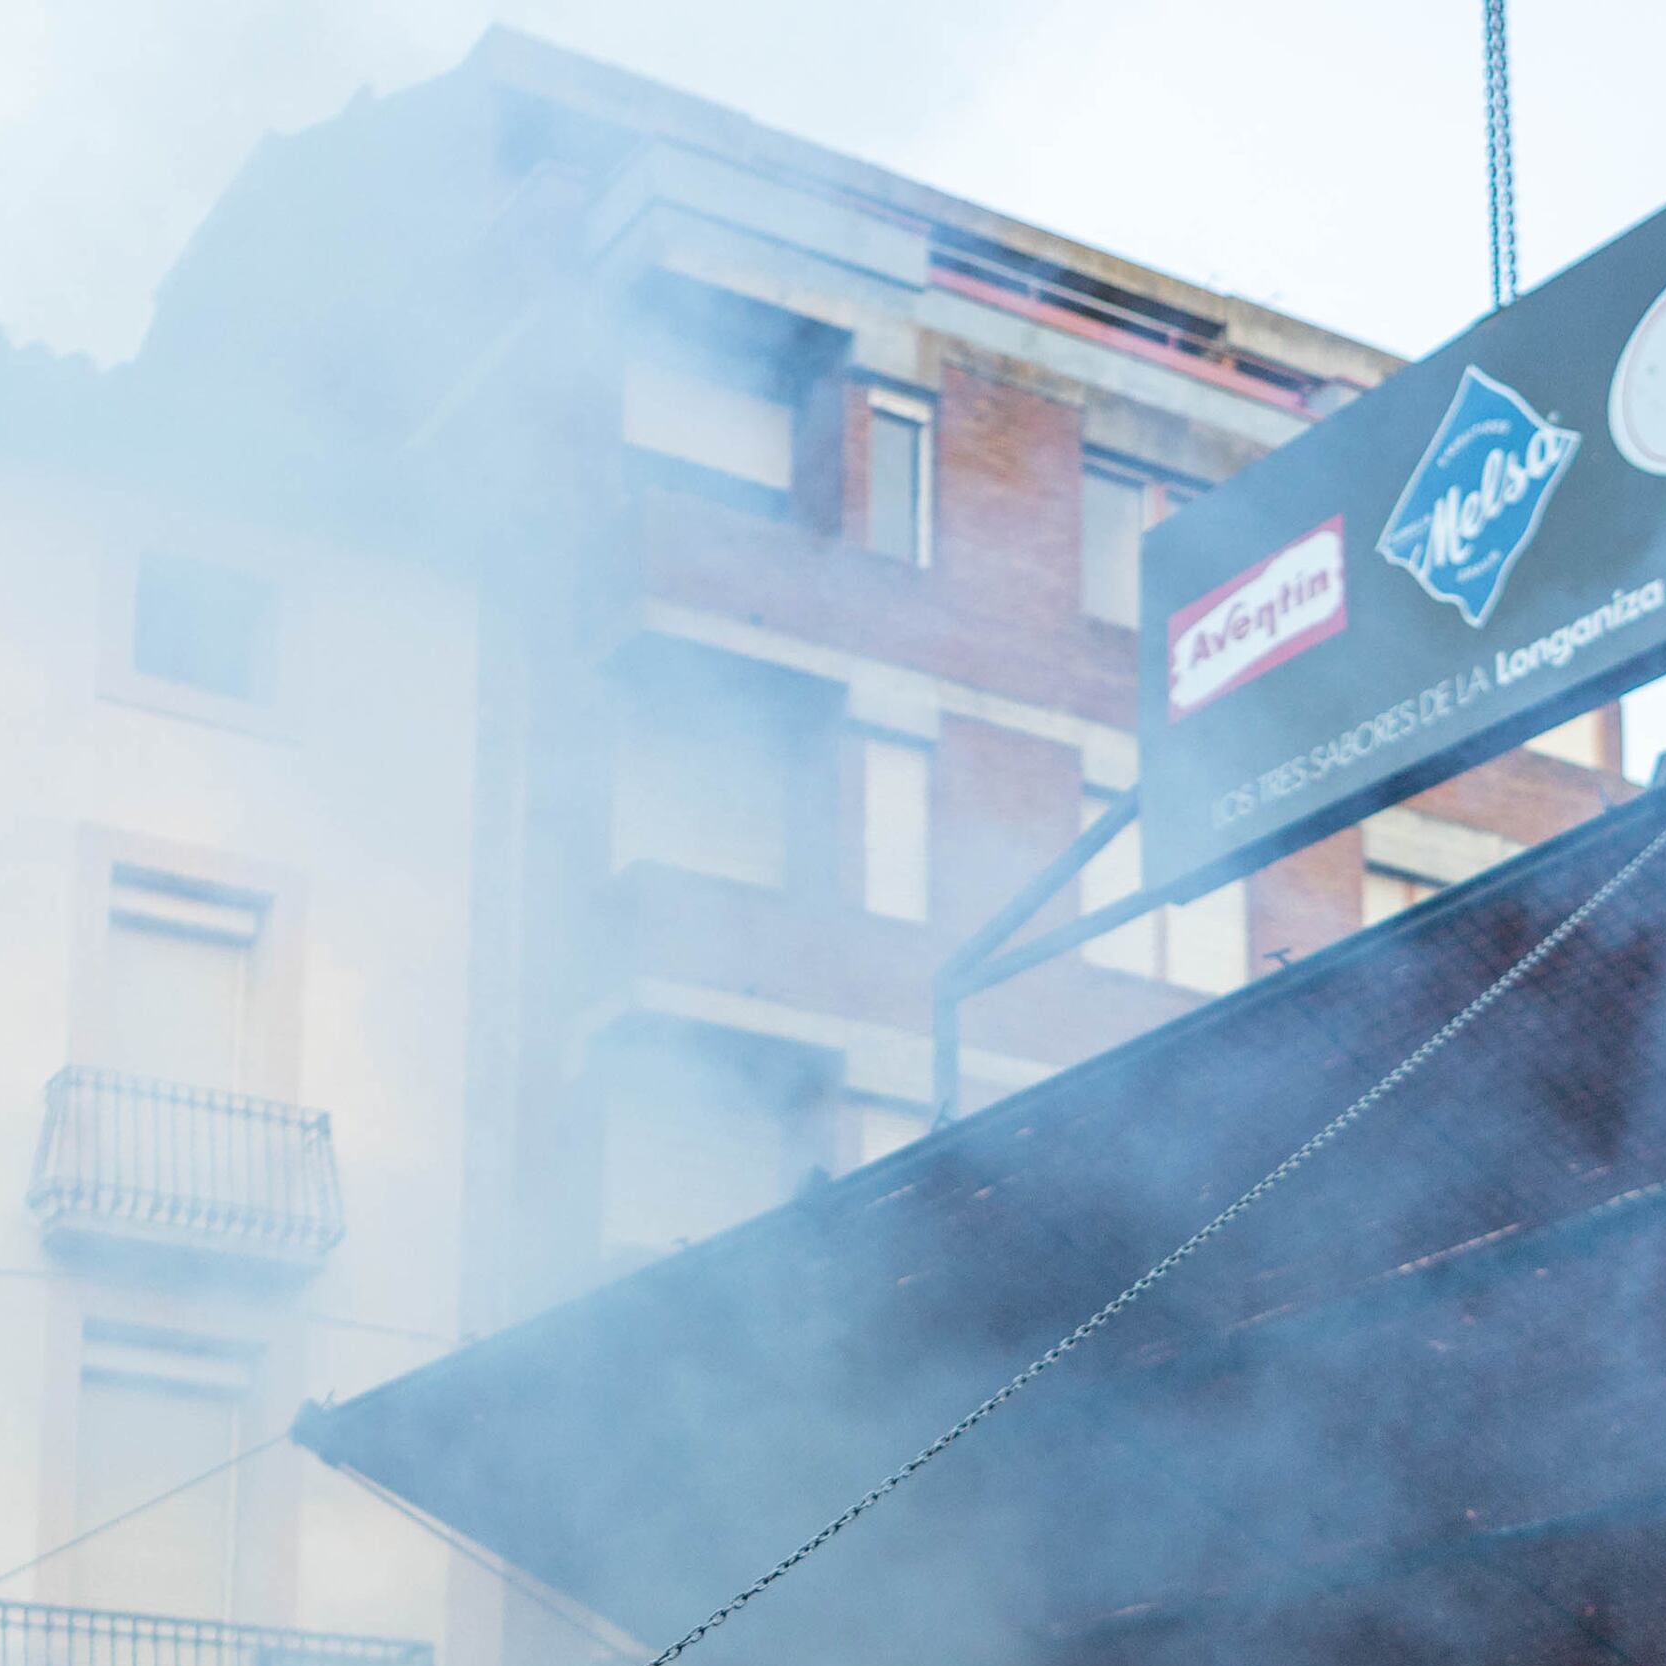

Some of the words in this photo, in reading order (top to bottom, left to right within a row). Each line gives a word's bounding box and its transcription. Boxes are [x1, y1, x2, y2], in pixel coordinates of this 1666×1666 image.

[1408, 427, 1564, 577] Melsa
[1257, 755, 1308, 802] TRES
[1309, 699, 1418, 780] SABORES
[1419, 679, 1454, 725] DE
[1455, 665, 1493, 705] LA
[1494, 577, 1666, 687] Longaniza
